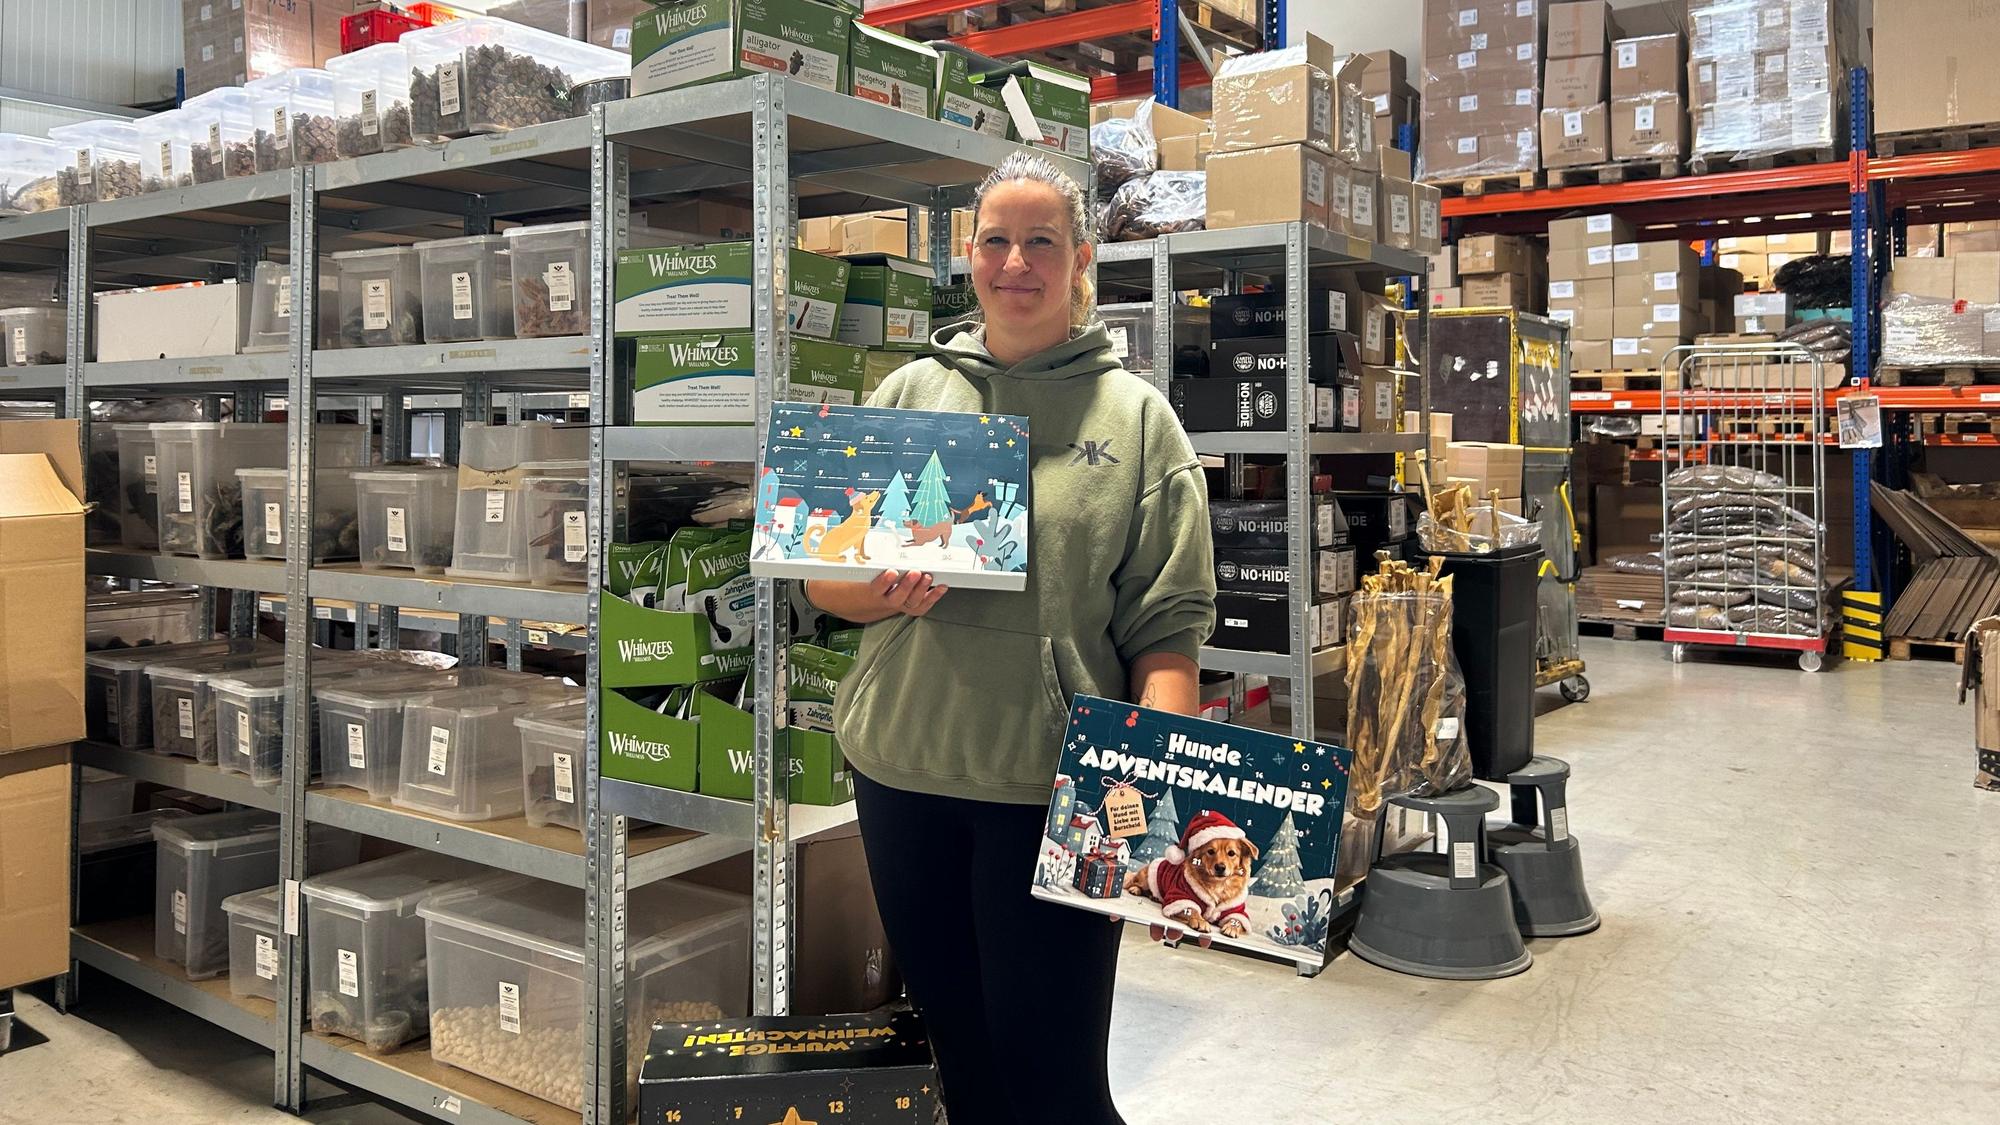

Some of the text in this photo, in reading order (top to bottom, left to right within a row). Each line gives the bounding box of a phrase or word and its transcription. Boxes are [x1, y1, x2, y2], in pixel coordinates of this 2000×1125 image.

[746, 35, 781, 50] alligator
[857, 72, 887, 89] hedgehog
[617, 638, 674, 663] WHIMZEES
[608, 731, 671, 762] WHIMZEES
[1168, 732, 1242, 767] Hunde
[1078, 745, 1325, 817] ADVENTSKALENDER
[683, 1027, 897, 1048] WEIHNACHTEN!
[729, 1040, 851, 1058] WUFFIGE
[828, 1101, 844, 1114] 13
[895, 1096, 910, 1110] 18
[734, 1106, 743, 1120] 7
